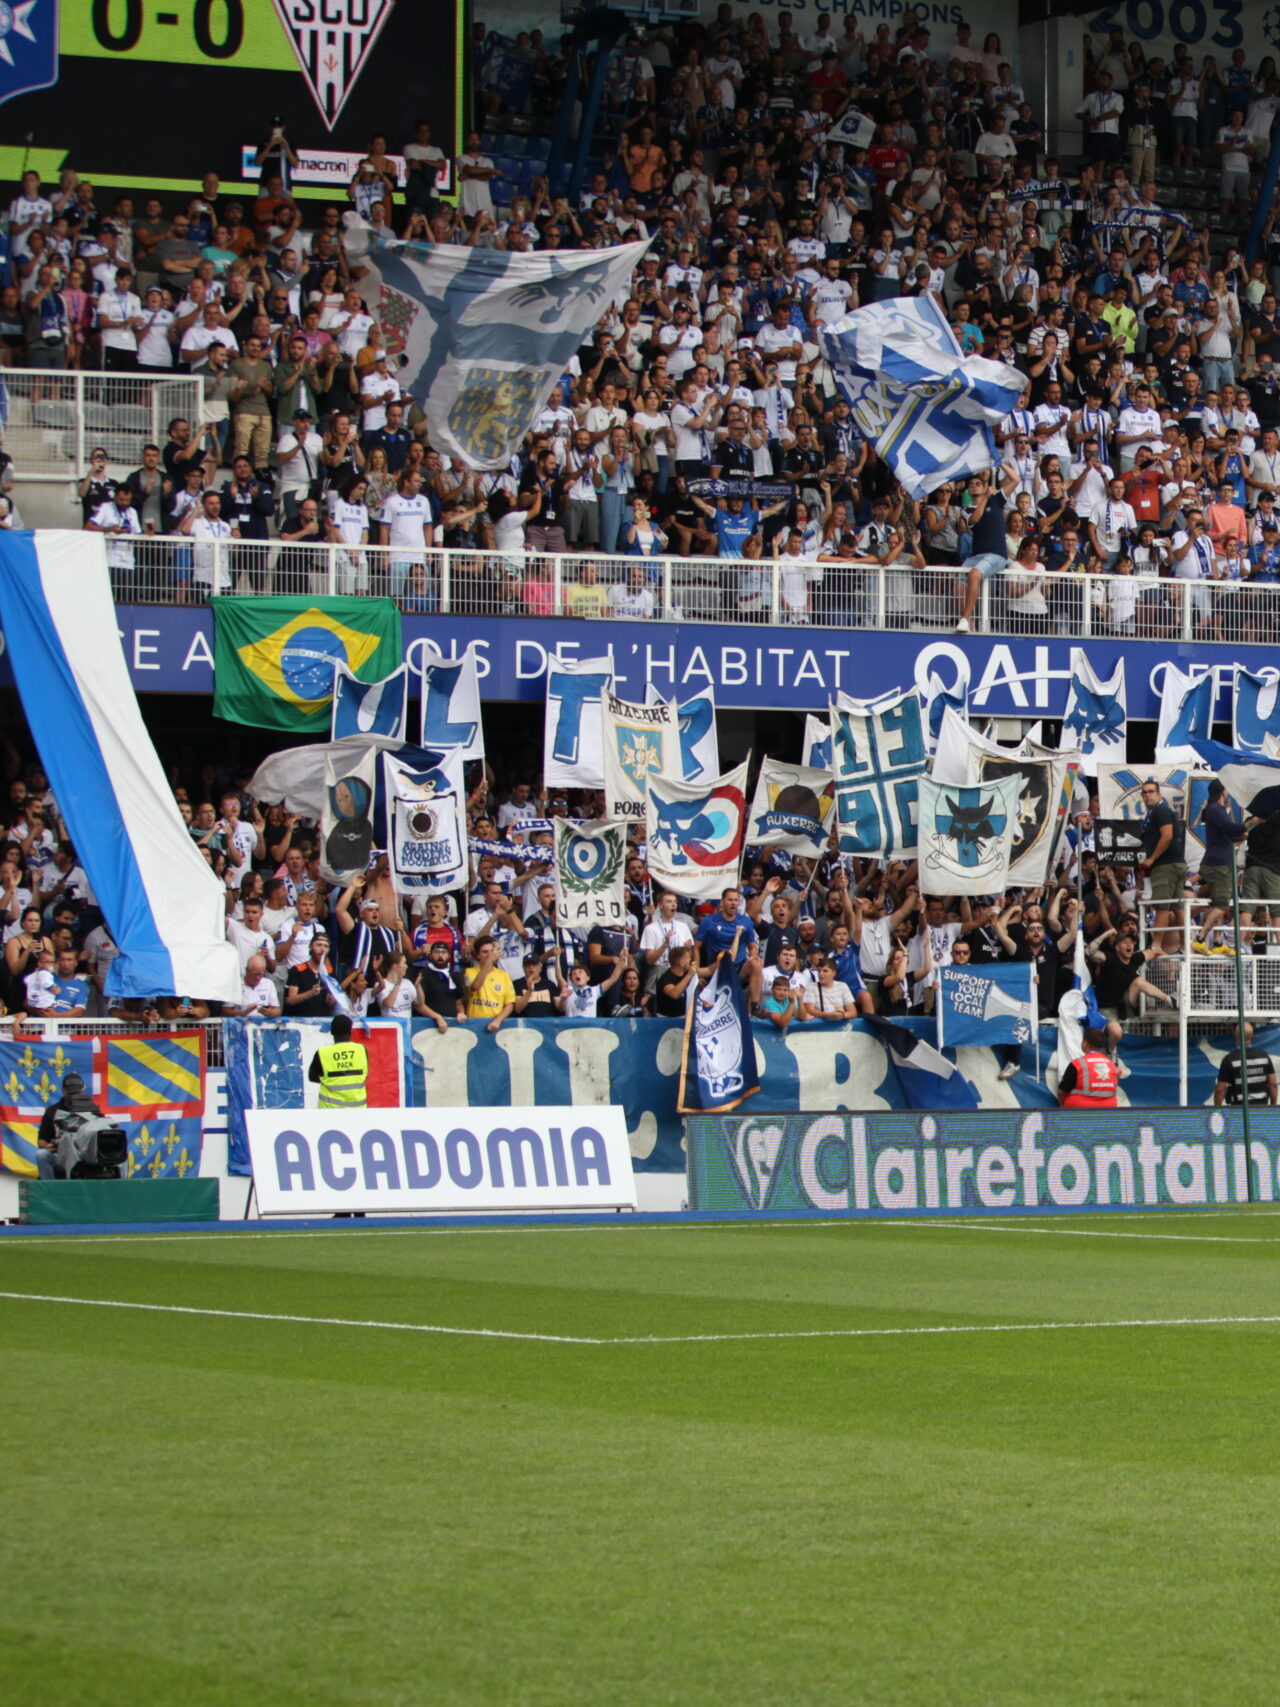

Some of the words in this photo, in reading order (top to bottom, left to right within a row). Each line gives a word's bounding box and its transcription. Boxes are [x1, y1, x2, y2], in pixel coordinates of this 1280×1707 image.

[1089, 0, 1244, 48] 2003
[607, 642, 851, 688] L'HABITAT
[765, 814, 821, 834] AUXERRE
[403, 839, 450, 850] AGAINST
[401, 856, 453, 867] FOOTBALL
[402, 848, 452, 861] MODERN
[943, 969, 991, 987] SUPPORT
[958, 983, 986, 998] YOUR
[950, 991, 984, 1008] LOCAL
[953, 1001, 985, 1019] TEAM!
[333, 1050, 356, 1061] 057
[336, 1061, 355, 1069] PACK
[274, 1127, 612, 1192] ACADOMIA
